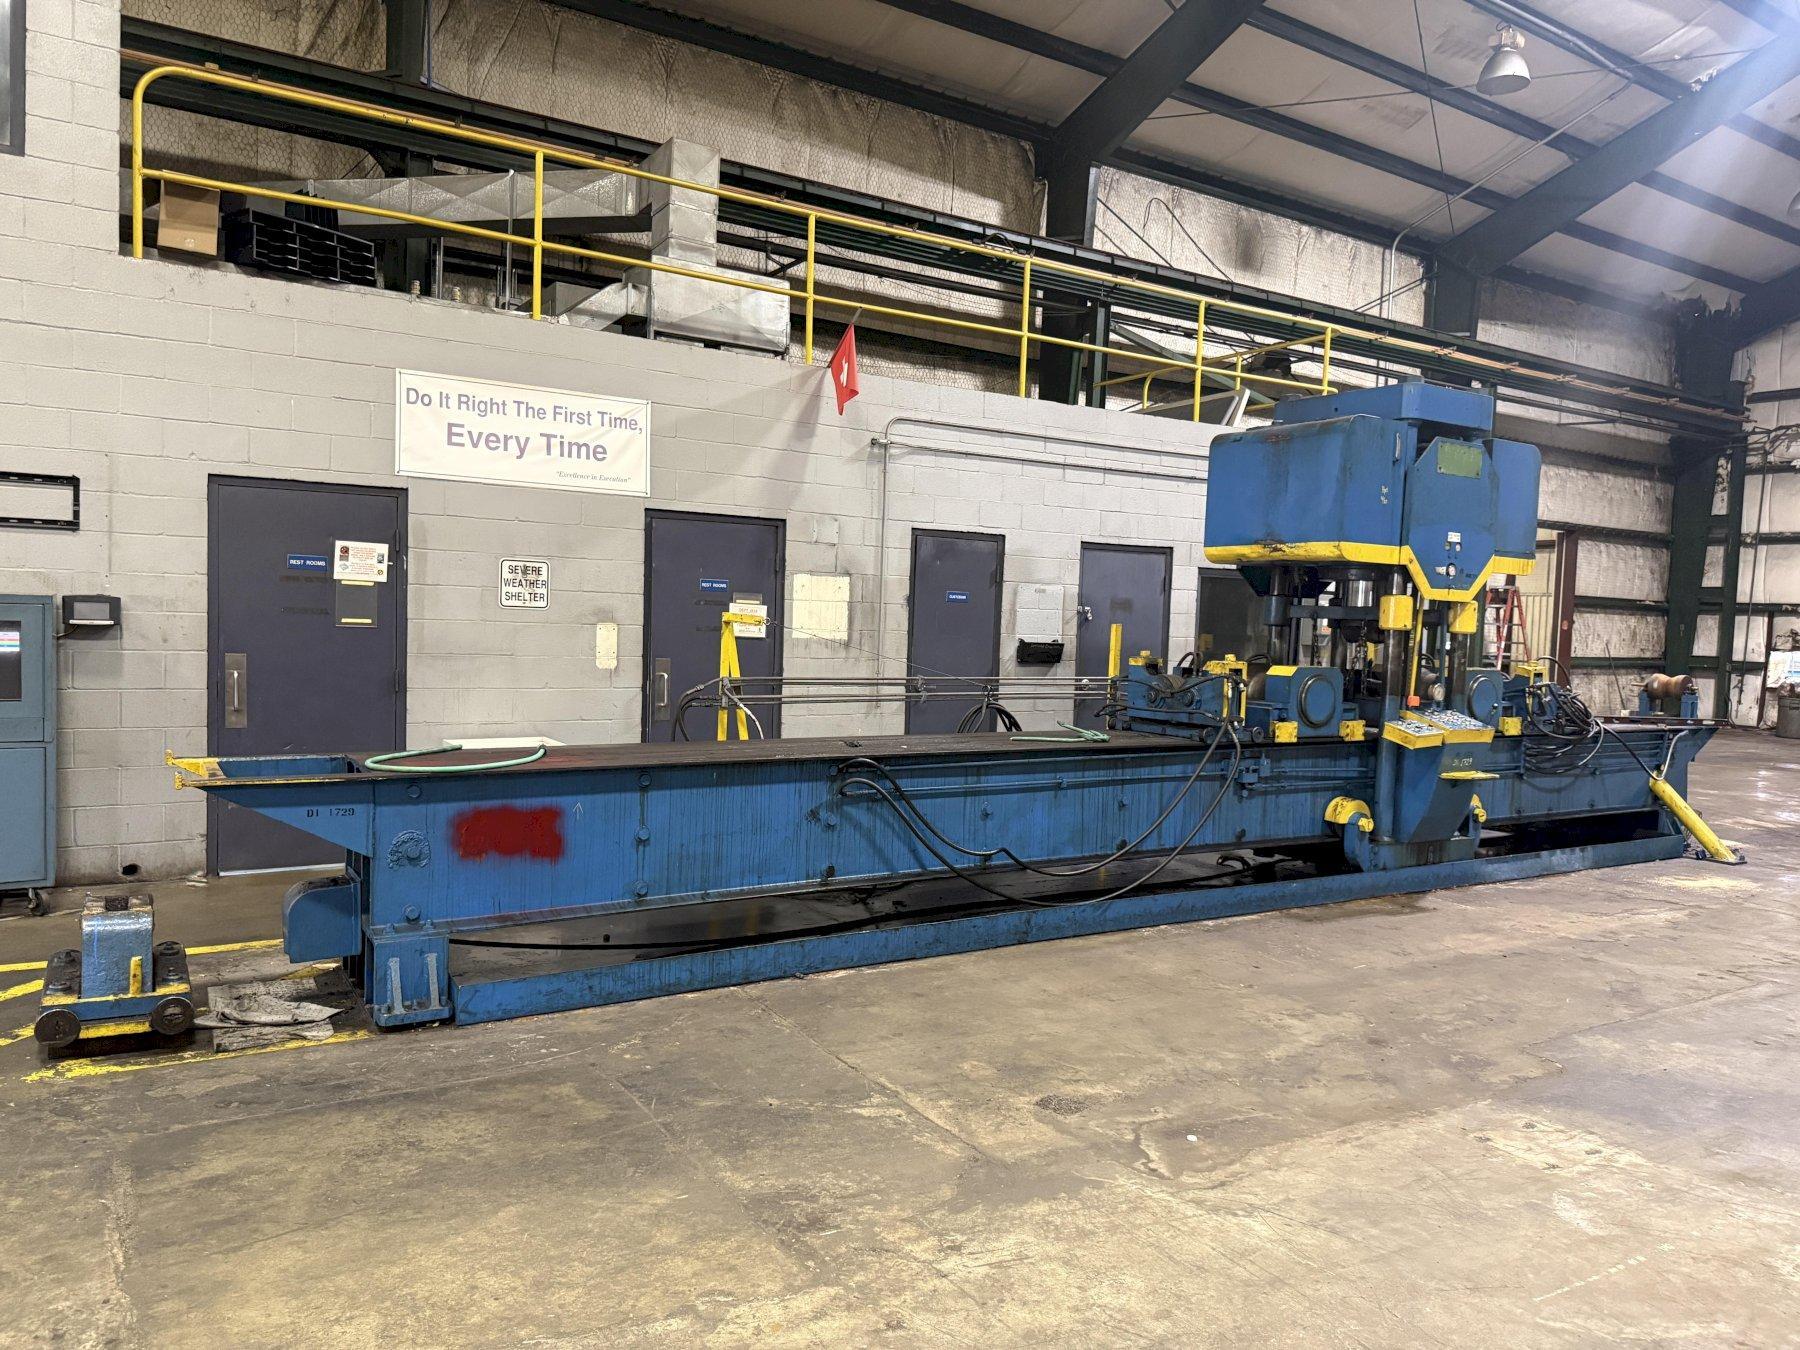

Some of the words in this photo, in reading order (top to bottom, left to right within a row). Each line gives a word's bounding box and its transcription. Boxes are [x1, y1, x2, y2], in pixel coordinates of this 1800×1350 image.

[406, 387, 432, 407] Do
[439, 391, 451, 409] It
[457, 393, 507, 418] Right
[513, 400, 547, 420] The
[553, 405, 592, 426] First
[597, 410, 643, 435] Time,
[446, 422, 530, 460] Every
[539, 432, 608, 462] Time
[508, 565, 542, 575] SEVERE
[503, 578, 547, 589] WEATHER
[505, 591, 545, 602] SHELTER
